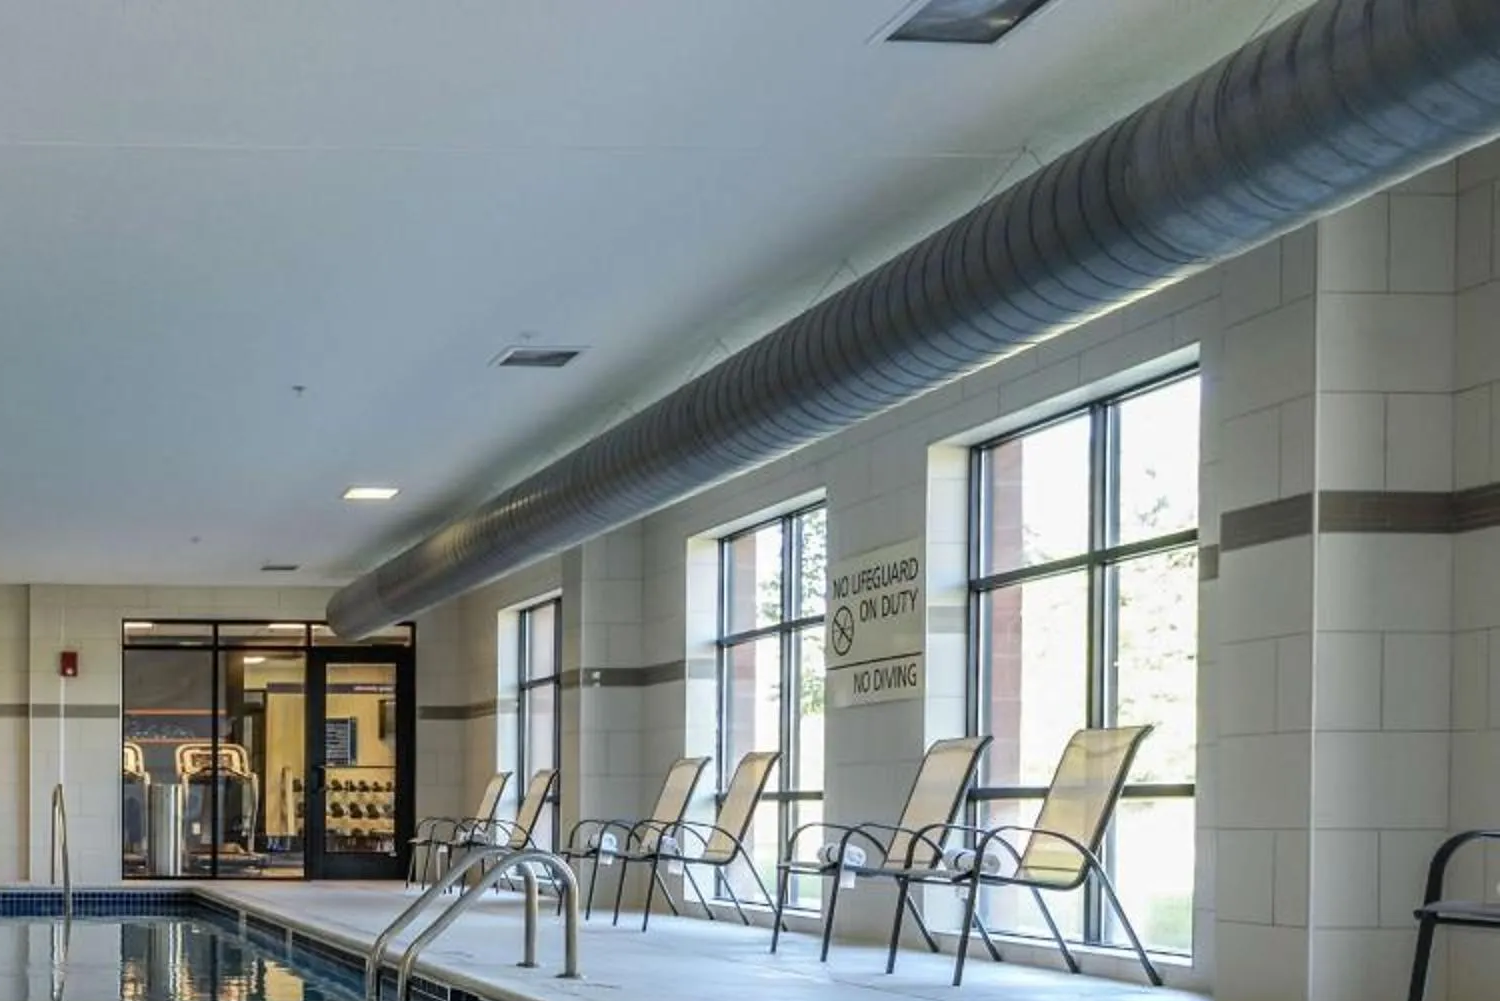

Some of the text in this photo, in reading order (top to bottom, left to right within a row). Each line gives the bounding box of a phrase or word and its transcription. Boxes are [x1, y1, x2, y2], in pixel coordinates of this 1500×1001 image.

[833, 557, 919, 600] NO LIFEGUARD
[859, 588, 919, 622] ON DUTY
[853, 663, 917, 694] NO DIVING
